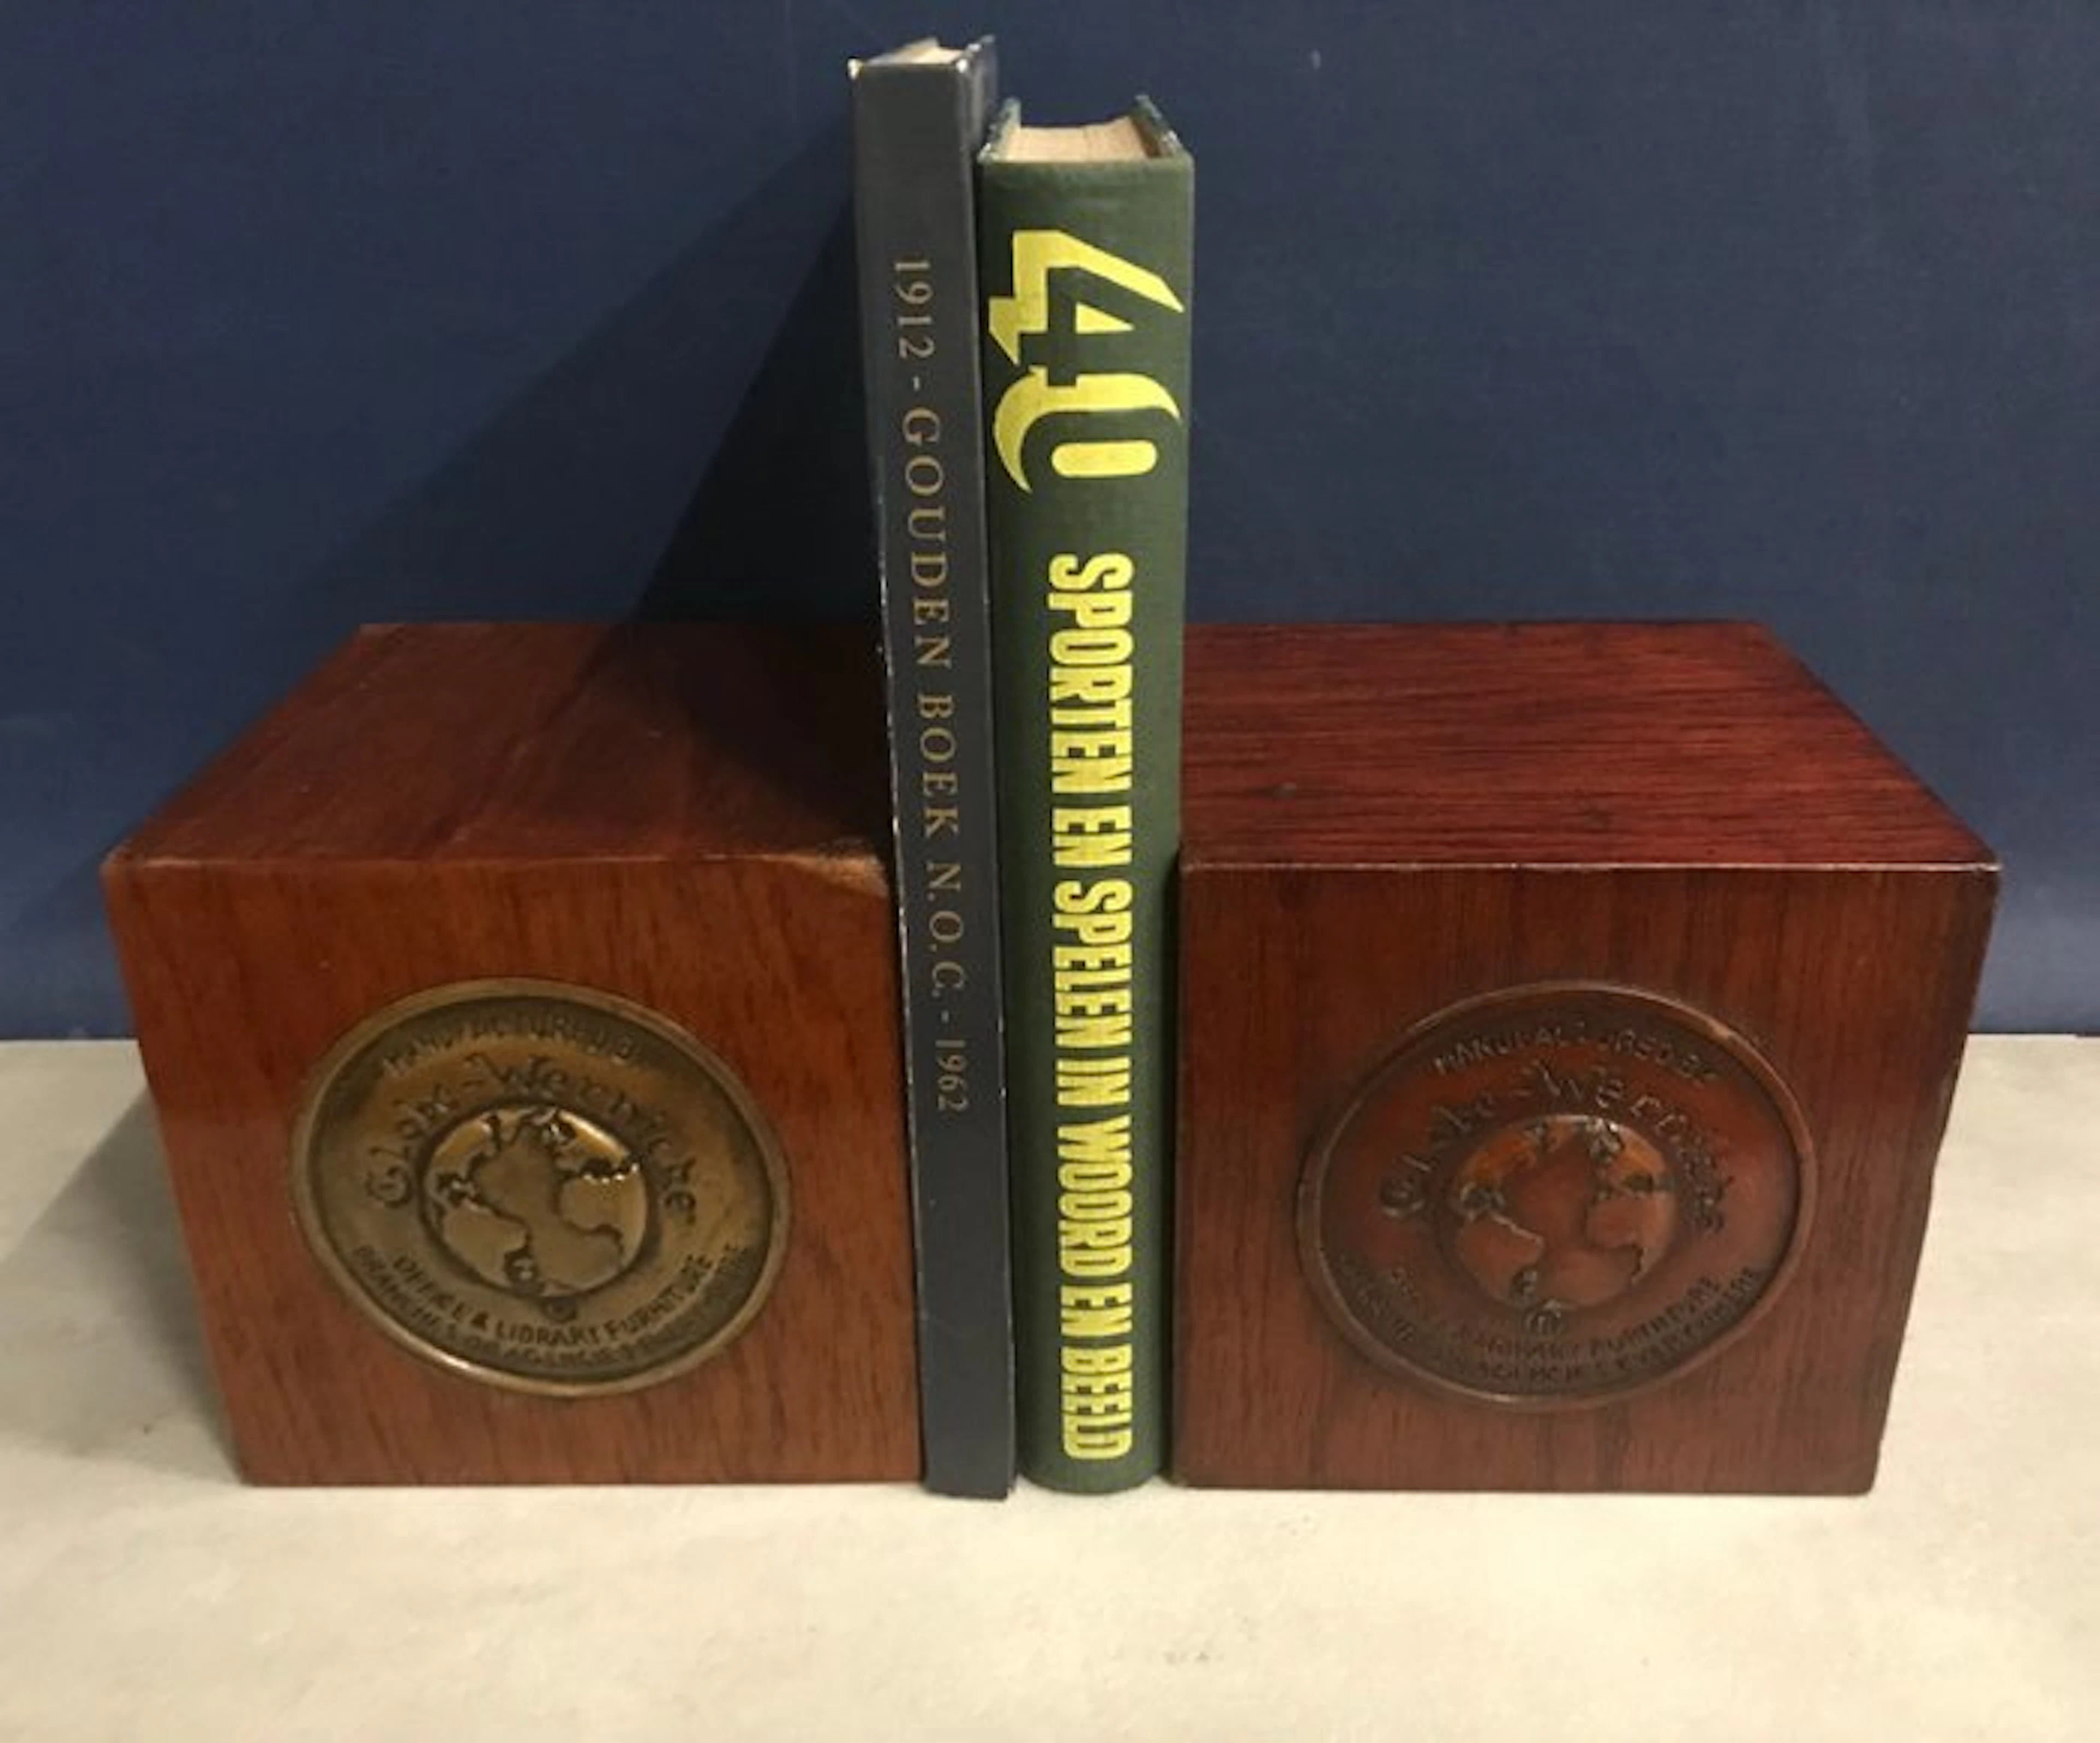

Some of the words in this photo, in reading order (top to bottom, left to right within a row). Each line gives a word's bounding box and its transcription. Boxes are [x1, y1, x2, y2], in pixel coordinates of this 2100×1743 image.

[894, 260, 936, 359] 1912
[988, 230, 1185, 494] 40
[902, 407, 953, 669] GOUDEN
[1047, 551, 1135, 794] SPORTEN
[917, 693, 959, 838] BOEK
[1051, 806, 1134, 867] EN
[925, 861, 965, 998] N.O.C.
[1053, 879, 1134, 1048] SPELEN
[935, 1038, 969, 1112] 1962
[1055, 1056, 1132, 1106] IN
[1056, 1114, 1134, 1277] WOORD
[1060, 1283, 1133, 1338] EN
[1060, 1343, 1133, 1460] BEELD
